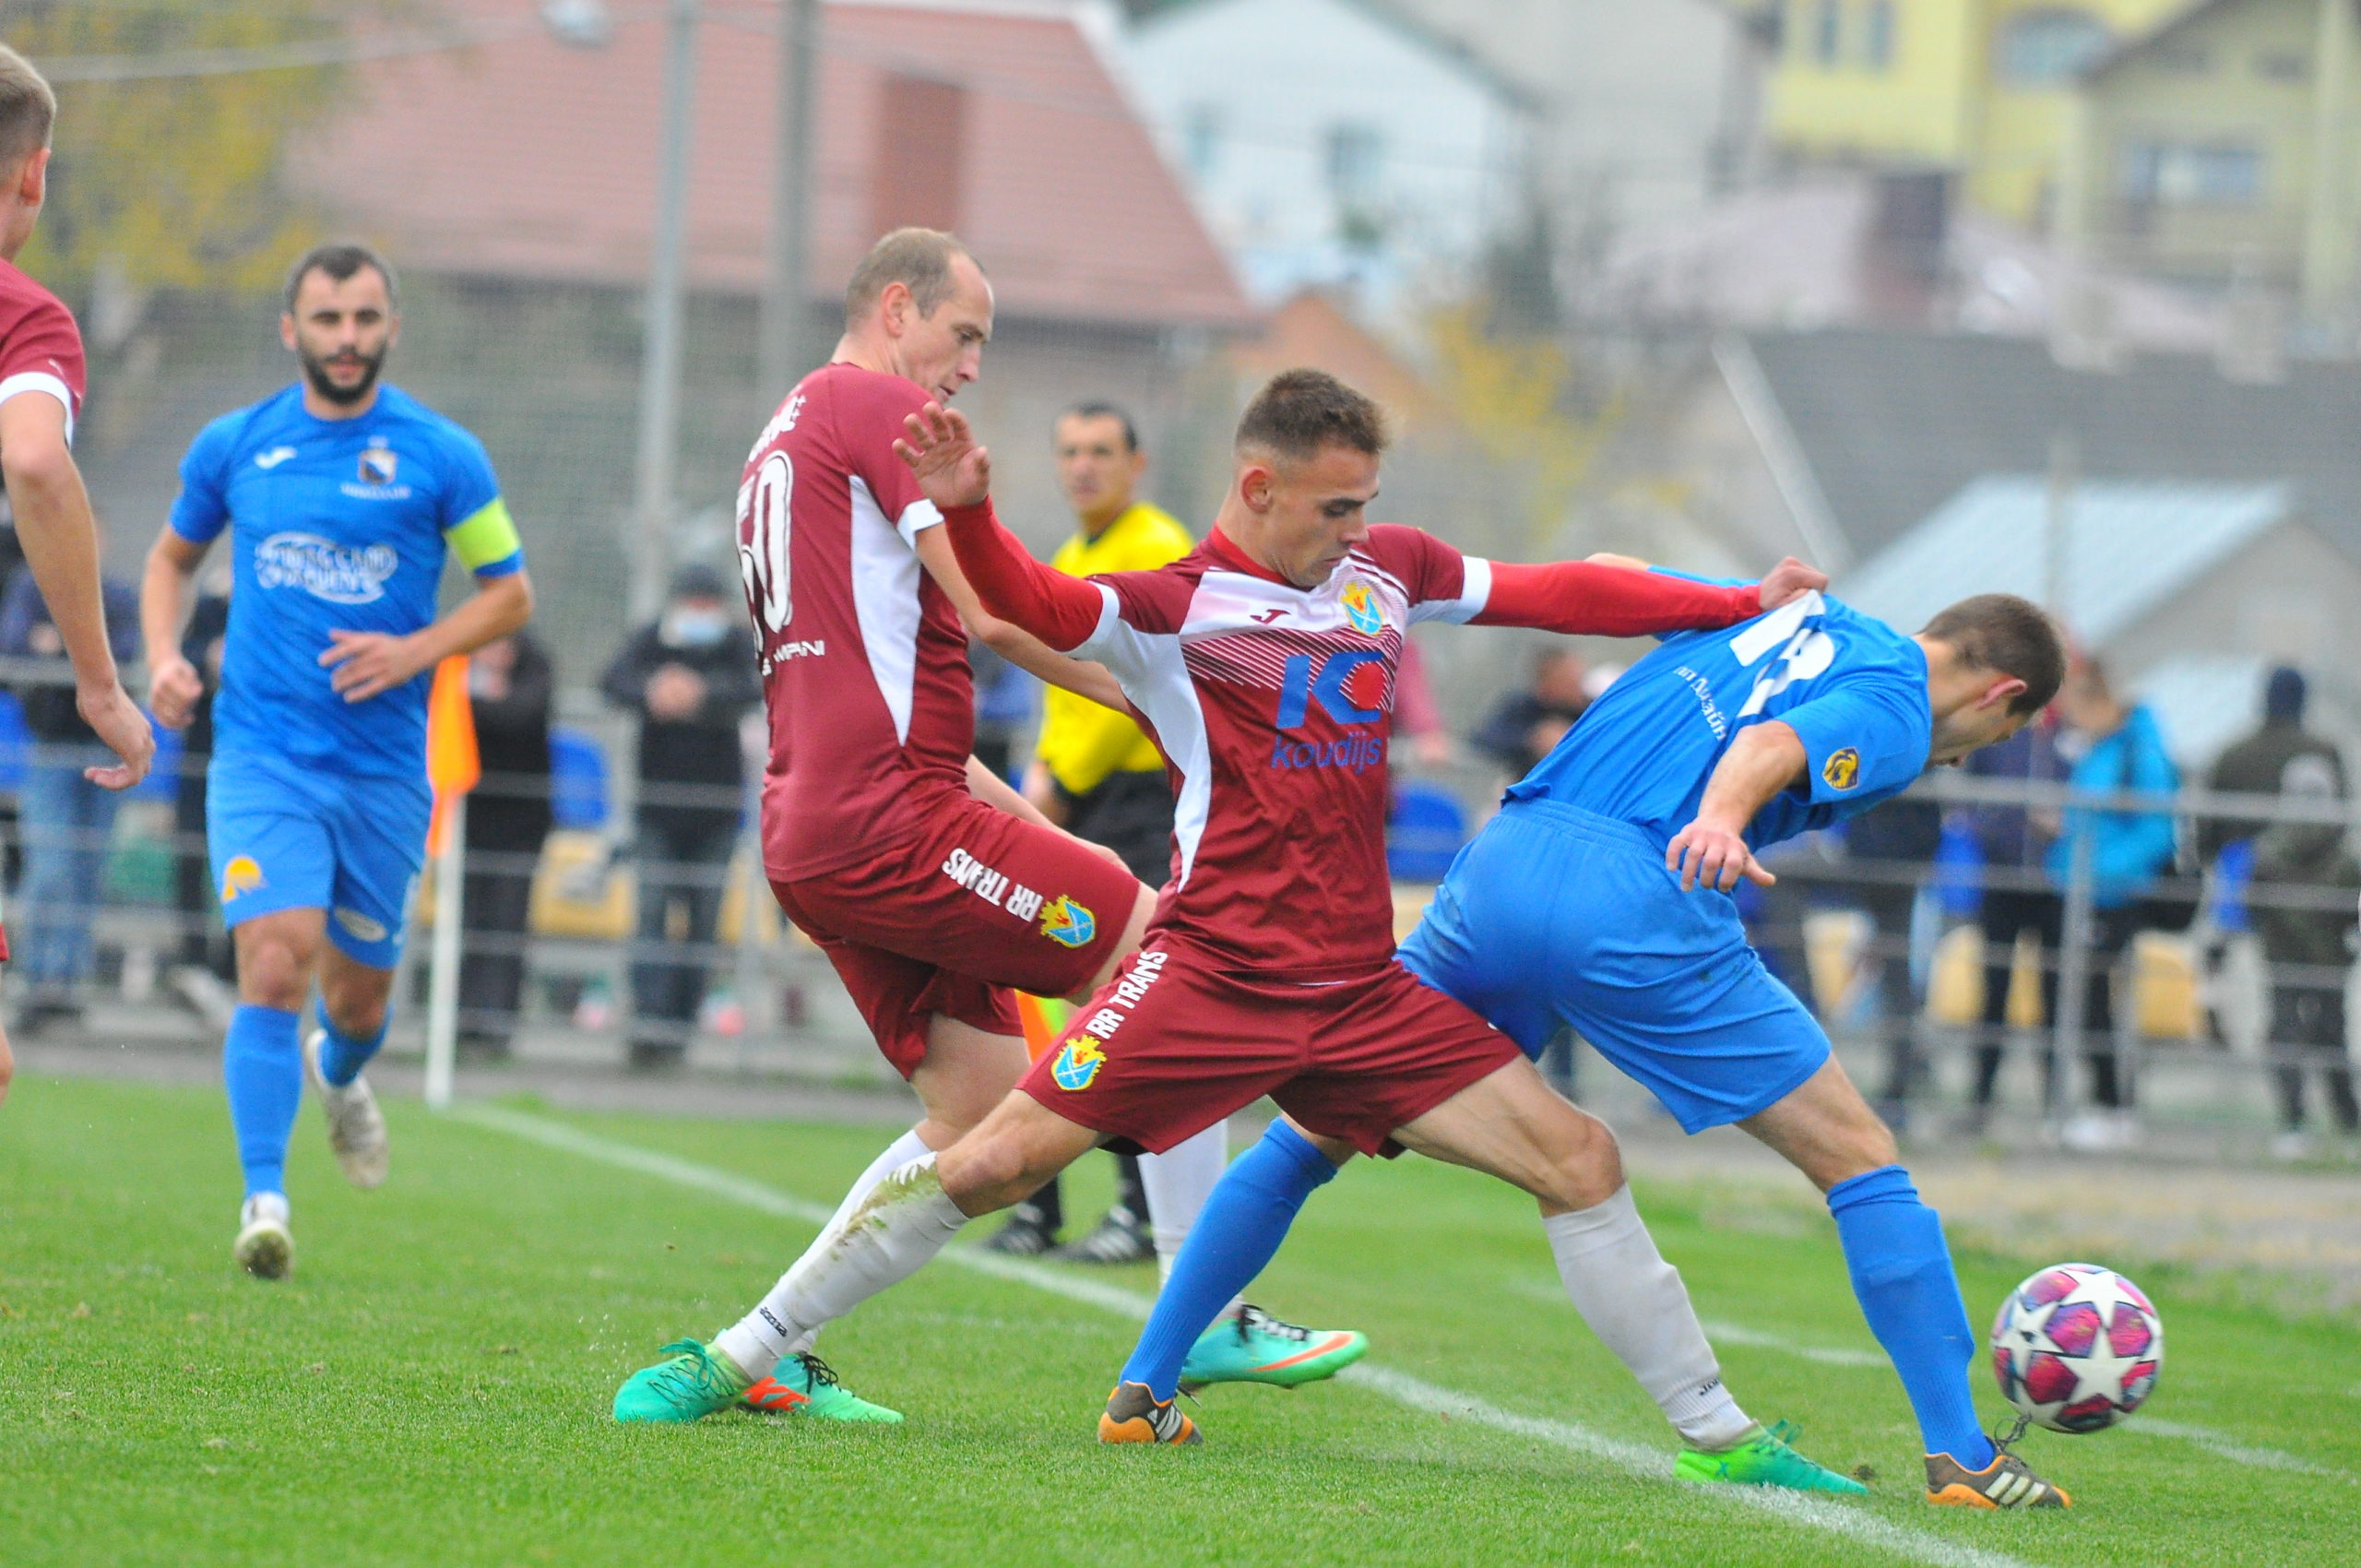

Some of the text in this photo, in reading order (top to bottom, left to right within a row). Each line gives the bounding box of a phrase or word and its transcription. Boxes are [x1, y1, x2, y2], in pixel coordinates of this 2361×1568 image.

[1271, 731, 1382, 774] koudijs
[942, 848, 1043, 922] RR TRANS
[1086, 951, 1169, 1039] RR TRANS
